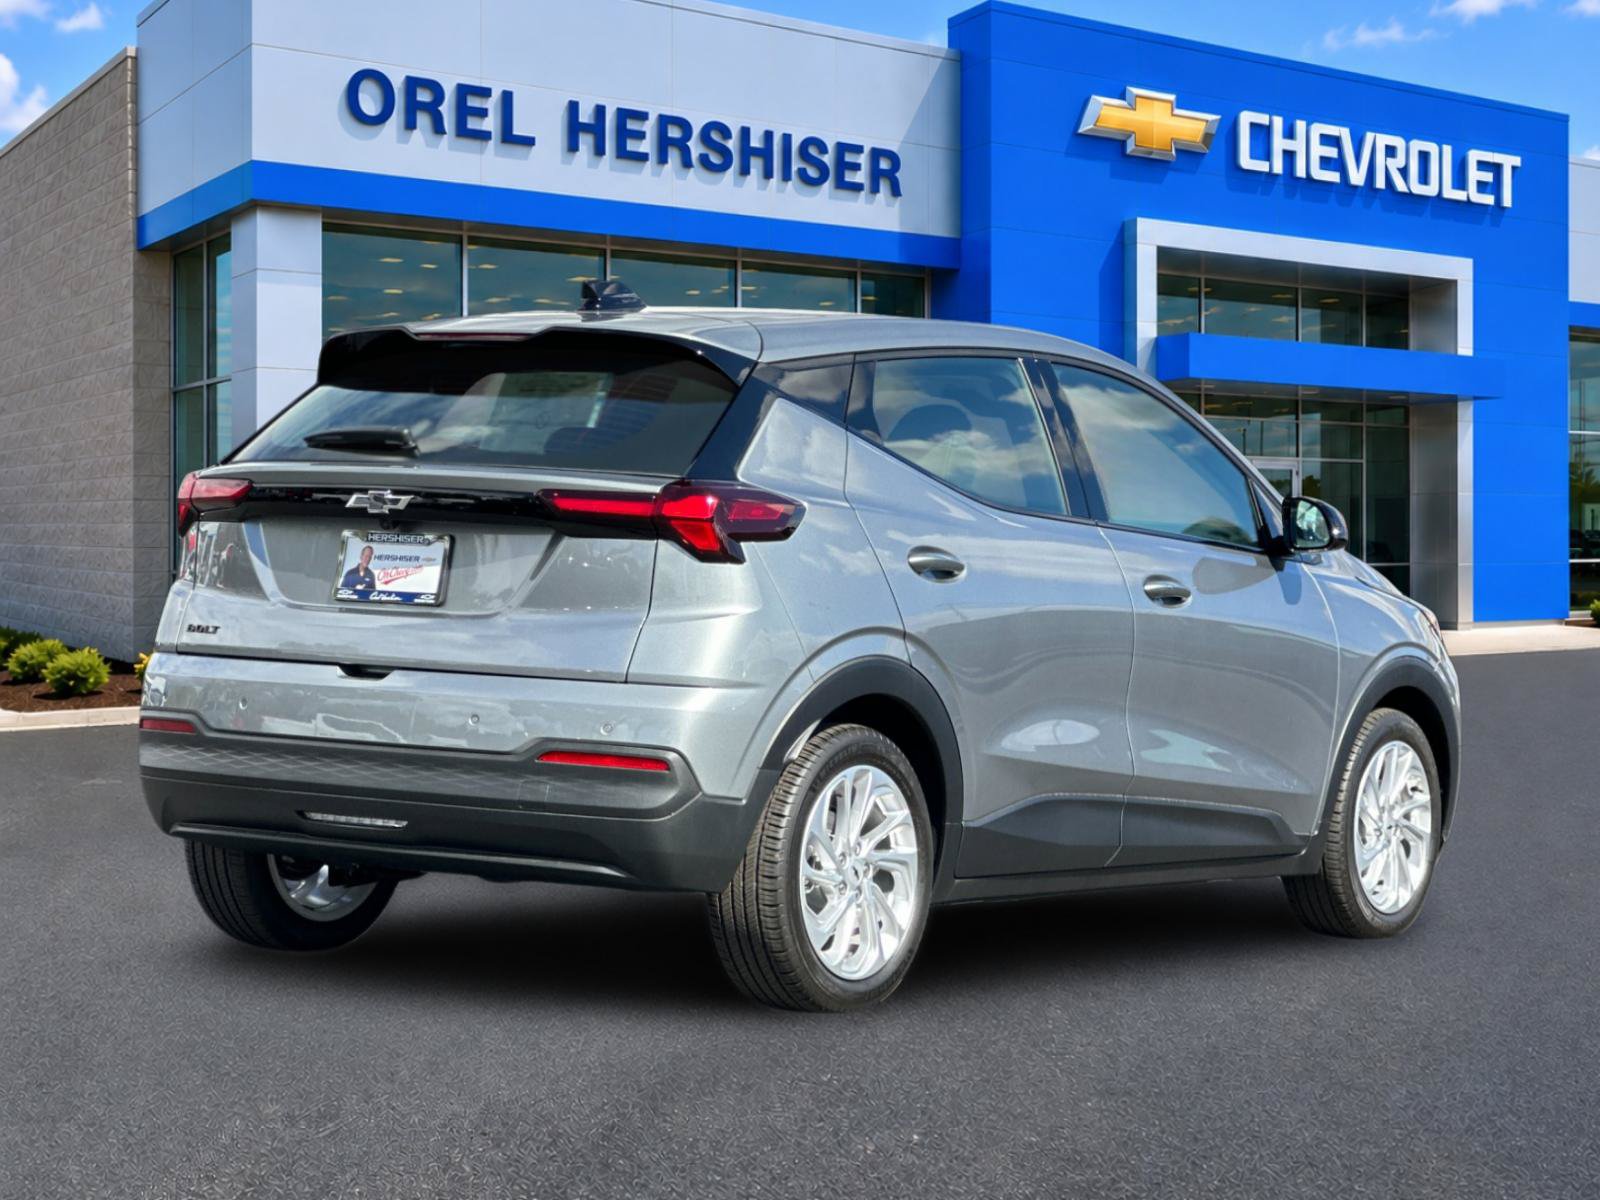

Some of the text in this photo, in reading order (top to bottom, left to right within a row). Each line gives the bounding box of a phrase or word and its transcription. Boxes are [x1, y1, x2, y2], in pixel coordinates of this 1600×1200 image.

[346, 69, 902, 197] OREL HERSHISER
[1238, 110, 1521, 207] CHEVROLET
[368, 533, 424, 543] HERSHISER
[374, 554, 420, 562] HERSHISER
